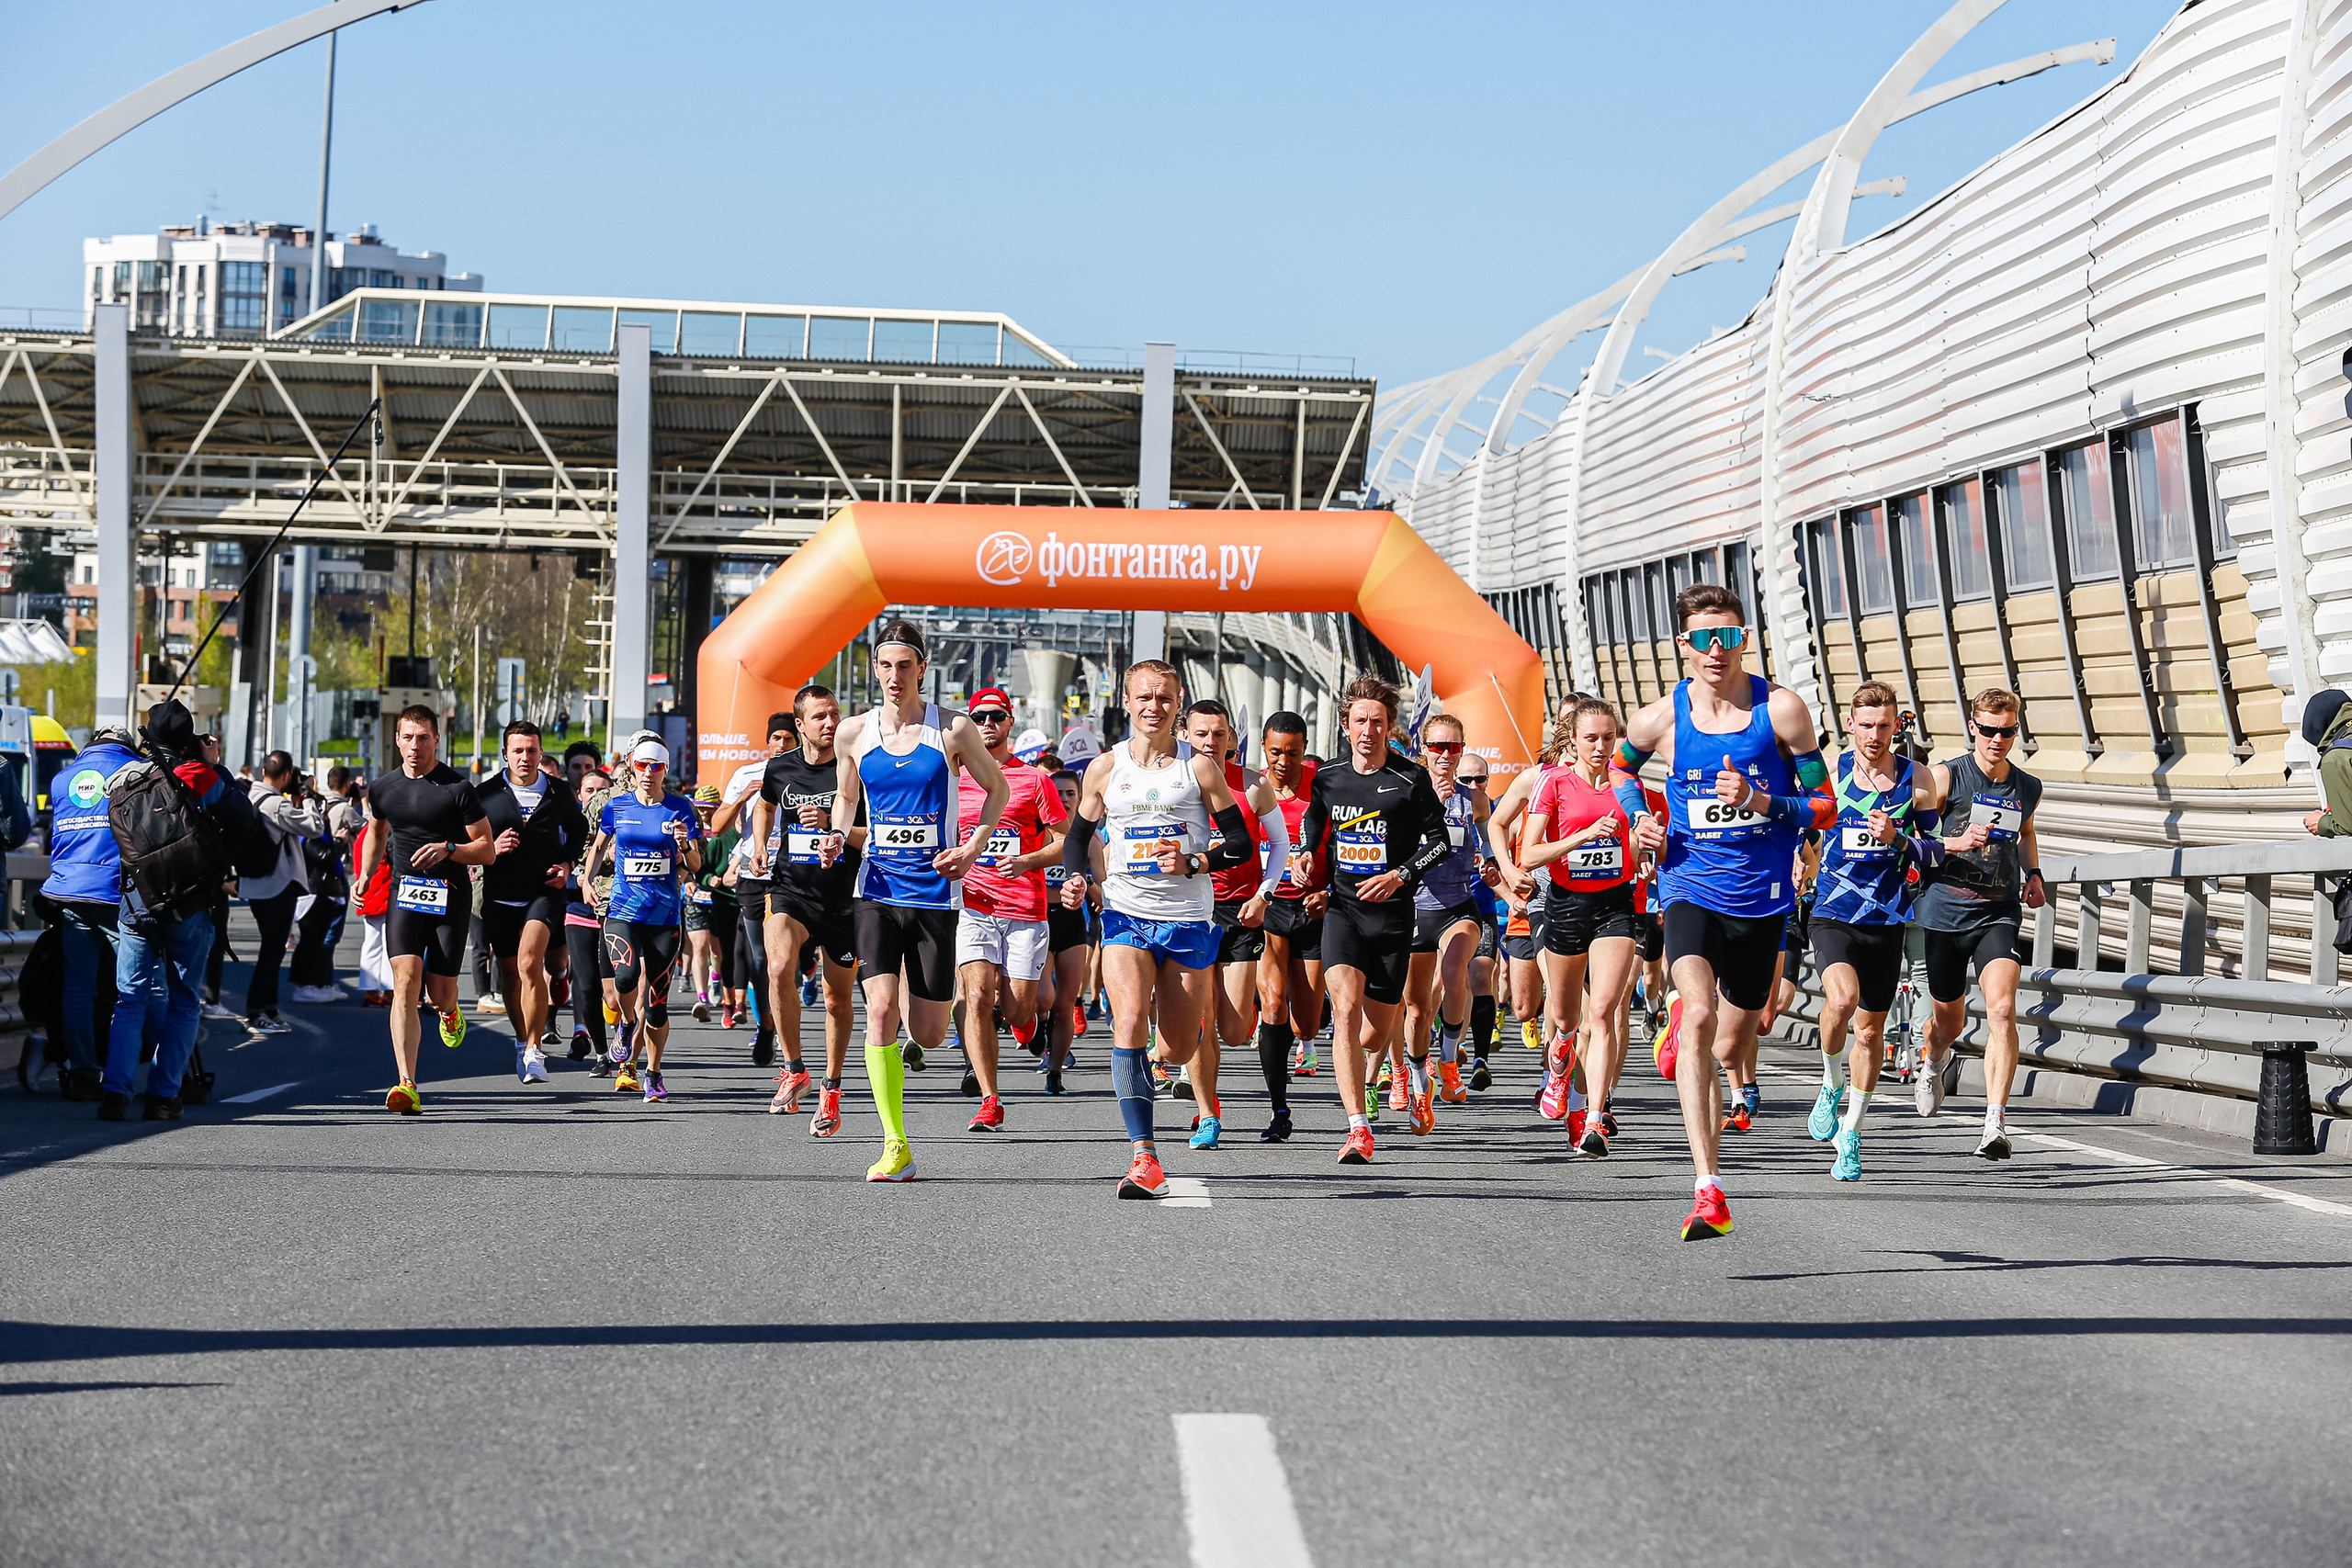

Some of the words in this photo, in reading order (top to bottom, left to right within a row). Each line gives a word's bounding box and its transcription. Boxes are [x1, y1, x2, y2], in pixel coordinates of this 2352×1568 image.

[1038, 532, 1262, 591] фонтанка.ру
[718, 749, 771, 761] НОВОС
[788, 793, 832, 808] NIKE
[1132, 804, 1152, 812] FBME
[1154, 804, 1174, 813] BANK
[1331, 805, 1363, 821] RUN
[1989, 811, 2003, 825] 2
[1354, 819, 1387, 835] LAB
[886, 829, 926, 844] 496
[1694, 830, 1724, 840] ЗАБЕГ
[1340, 846, 1381, 861] 2000
[1415, 840, 1447, 870] saucony
[1580, 851, 1613, 866] 783
[635, 862, 662, 873] 775
[1046, 867, 1067, 878] 47
[1129, 864, 1151, 874] ЗАБЕГ
[407, 888, 438, 902] 463
